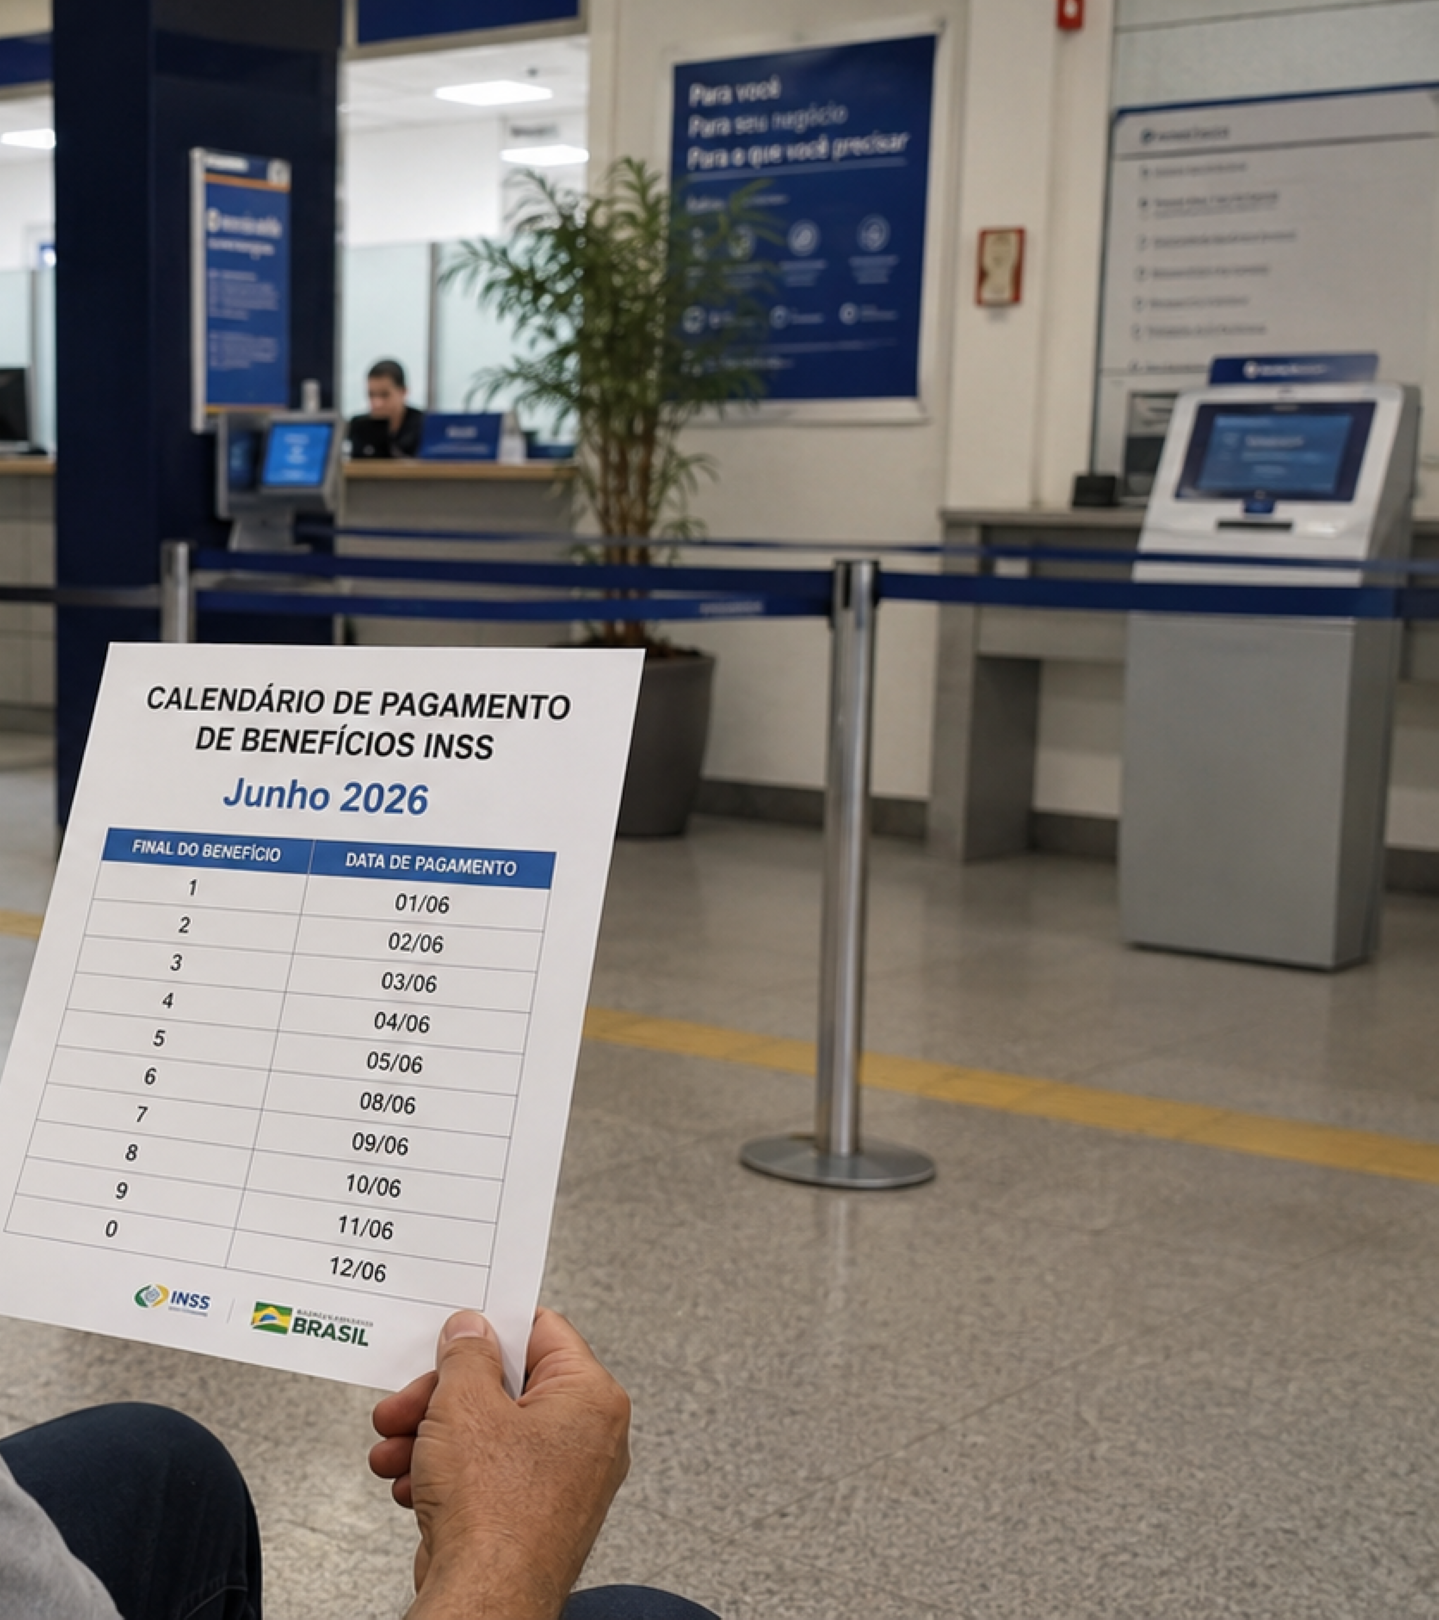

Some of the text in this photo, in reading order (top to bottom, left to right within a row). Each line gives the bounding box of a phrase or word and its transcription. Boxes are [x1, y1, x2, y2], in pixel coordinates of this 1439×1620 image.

[689, 75, 781, 107] Para você
[688, 114, 731, 138] Para
[687, 146, 729, 170] Para
[731, 147, 745, 166] o
[748, 144, 782, 168] que
[786, 134, 829, 161] você
[146, 682, 572, 721] CALENDÁRIO DE PAGAMENTO
[194, 724, 495, 761] DE BENEFÍCIOS INSS
[222, 777, 429, 816] Junho 2026
[132, 839, 281, 863] FINAL DO BENEFÍCIO
[346, 852, 518, 877] DATA DE PAGAMENTO
[189, 878, 197, 897] 1
[394, 892, 450, 915] 01/06
[178, 916, 192, 934] 2
[388, 931, 445, 954] 02/06
[169, 953, 183, 972] 3
[381, 971, 438, 994] 03/06
[161, 992, 174, 1009] 4
[373, 1011, 431, 1034] 04/06
[152, 1028, 166, 1047] 5
[366, 1050, 424, 1075] 05/06
[143, 1066, 157, 1086] 6
[136, 1105, 149, 1123] 7
[359, 1091, 417, 1116] 08/06
[124, 1143, 139, 1162] 8
[351, 1131, 409, 1157] 09/06
[115, 1181, 129, 1200] 9
[346, 1173, 402, 1199] 10/06
[105, 1219, 119, 1238] 0
[338, 1214, 395, 1241] 11/06
[329, 1255, 388, 1283] 12/06
[170, 1290, 211, 1310] INSS
[292, 1316, 369, 1347] BRASIL
